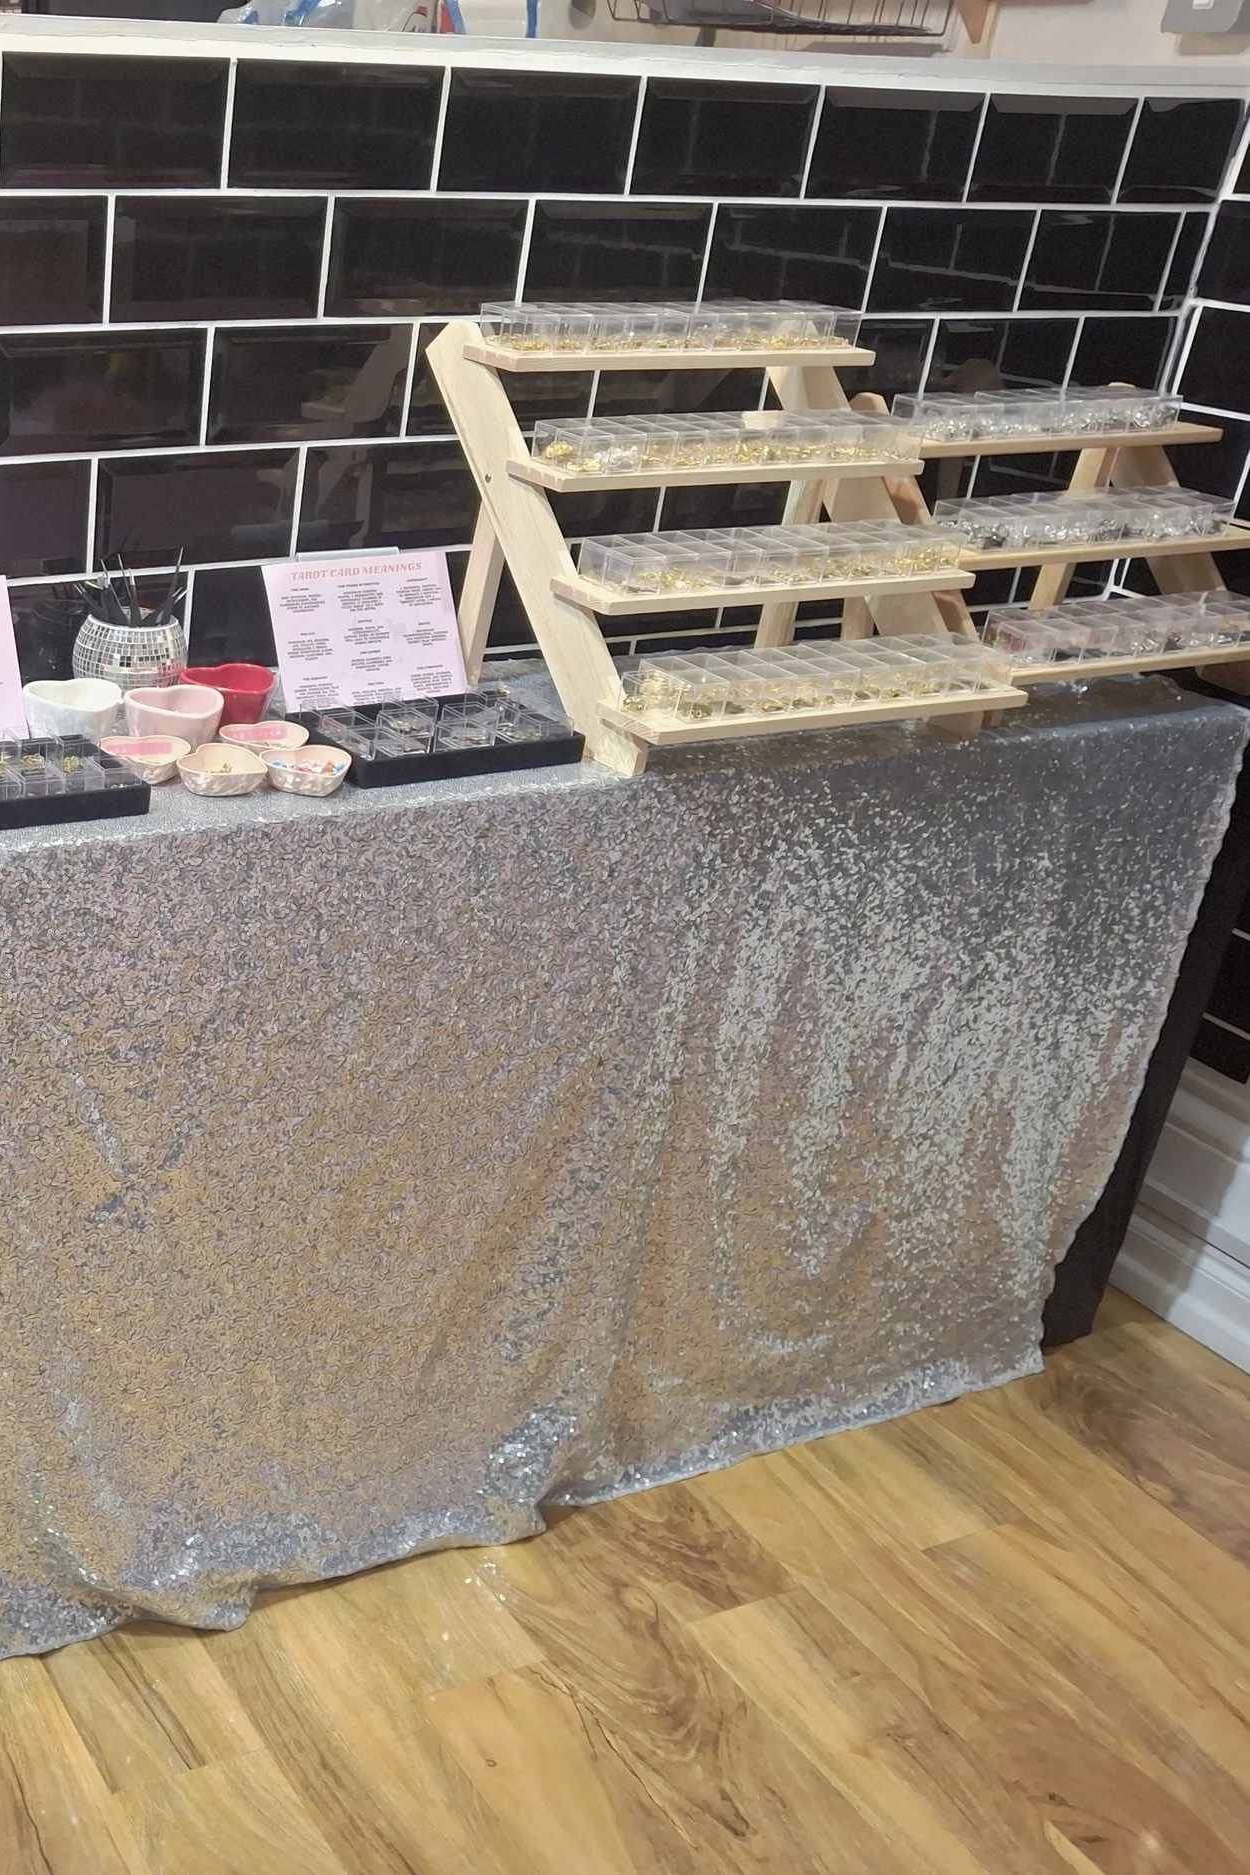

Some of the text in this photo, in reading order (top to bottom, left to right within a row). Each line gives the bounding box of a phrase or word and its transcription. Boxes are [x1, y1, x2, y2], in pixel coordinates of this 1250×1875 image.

[291, 562, 423, 581] TAROT CARD MEANINGS
